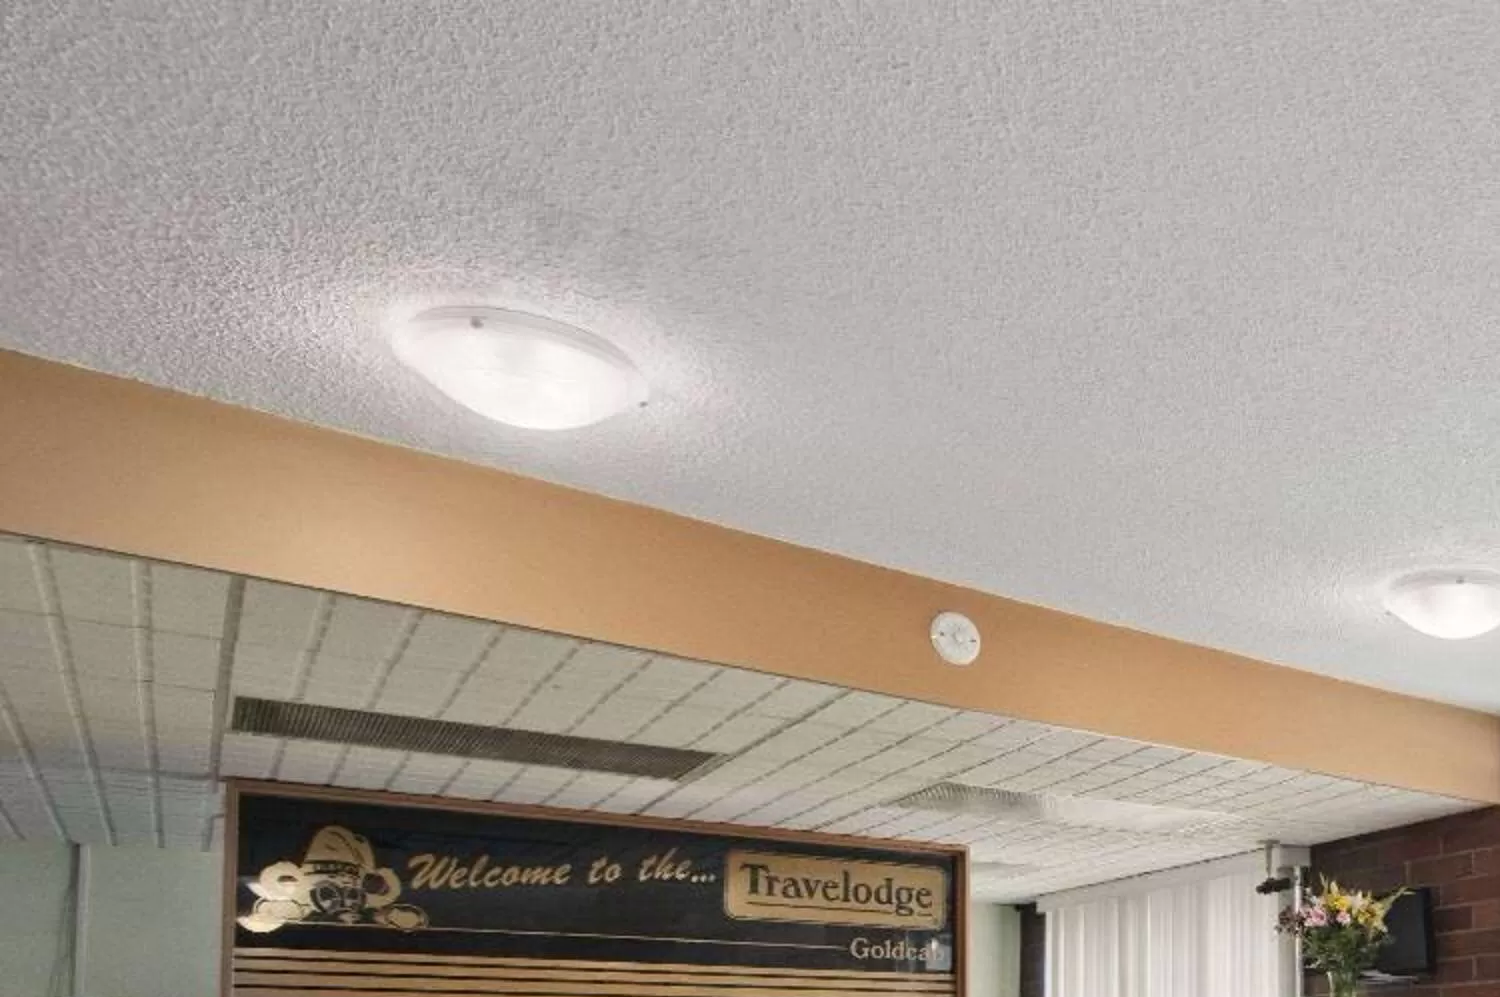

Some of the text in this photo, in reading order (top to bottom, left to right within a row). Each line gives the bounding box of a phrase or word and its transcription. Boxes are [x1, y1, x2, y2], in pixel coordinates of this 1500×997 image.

[407, 847, 715, 890] Welcome to the...
[739, 862, 933, 917] Travelodge
